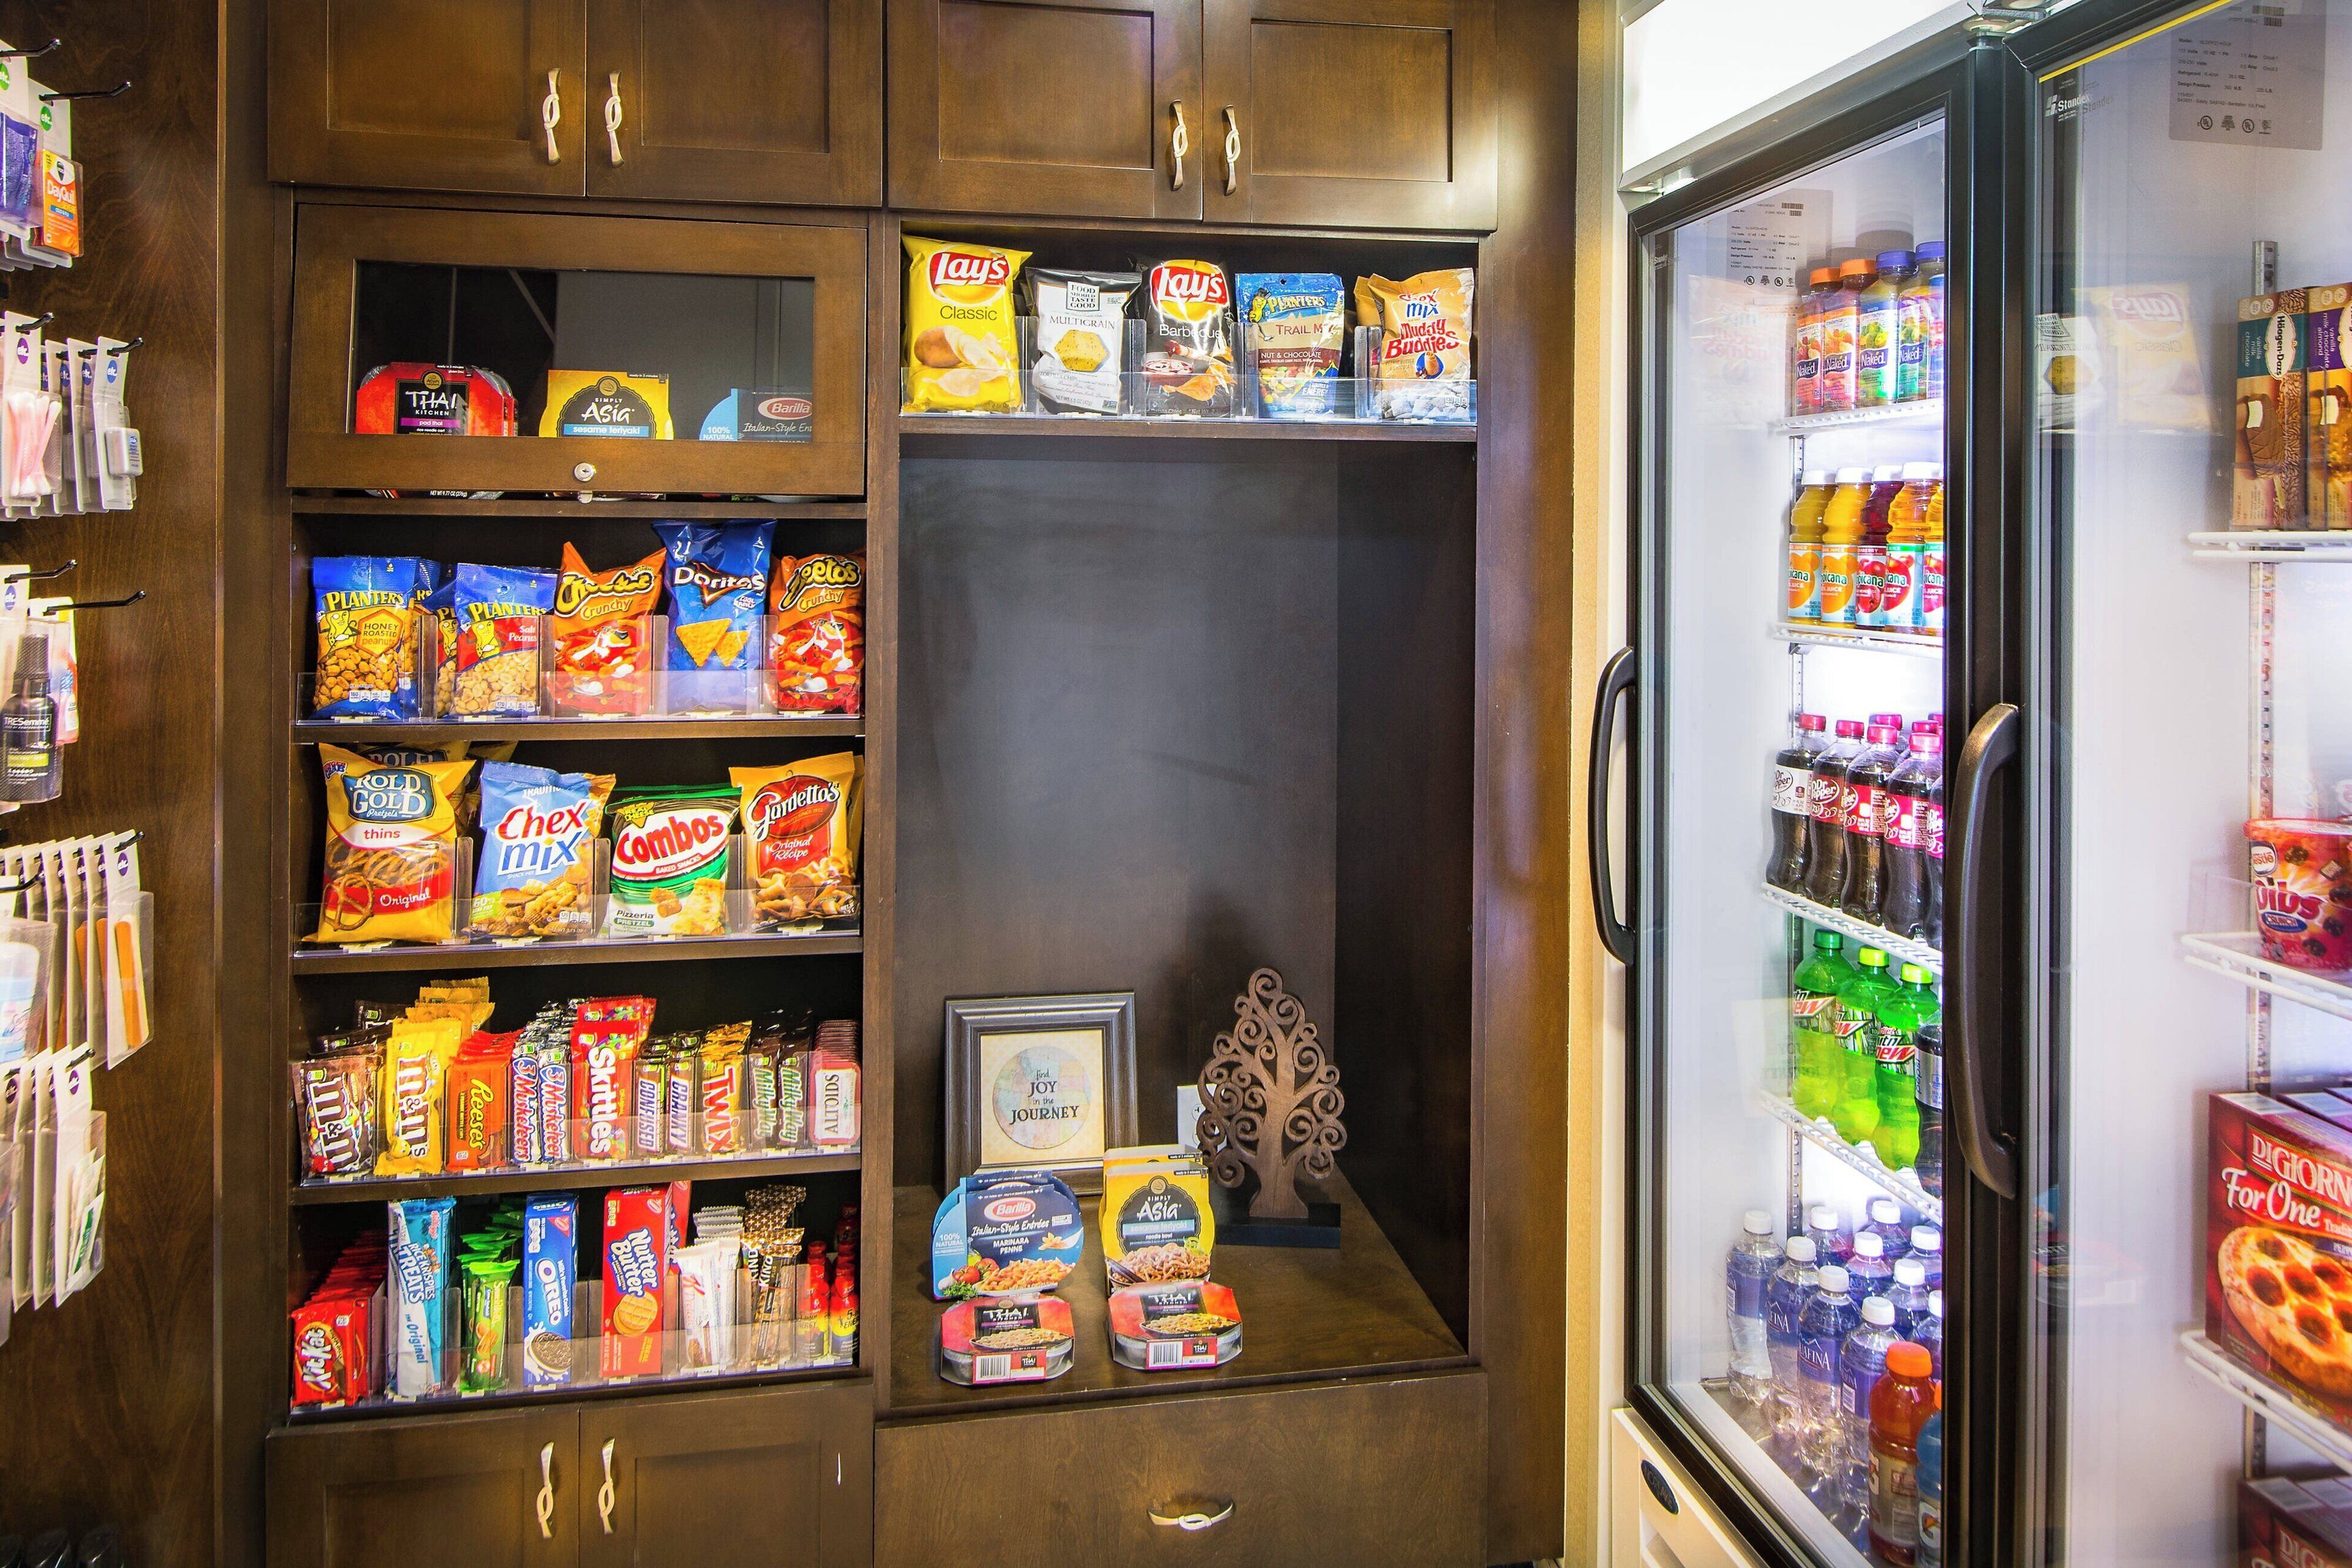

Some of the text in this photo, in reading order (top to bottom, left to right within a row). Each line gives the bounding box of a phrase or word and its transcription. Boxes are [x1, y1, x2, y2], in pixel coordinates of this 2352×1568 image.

[40, 112, 53, 126] etc.
[47, 178, 74, 205] DayQui
[931, 251, 1008, 286] Lay's
[1071, 284, 1096, 294] FOOD
[1156, 265, 1223, 302] Lay's
[940, 305, 998, 321] Classic
[1267, 295, 1326, 312] PLANTERS
[1049, 315, 1115, 330] MULTIGRAIN
[1276, 324, 1311, 335] TRAIL
[1401, 318, 1447, 340] Muddy
[17, 345, 29, 357] etc.
[1384, 330, 1460, 360] Buddies
[1900, 346, 1920, 363] Naked
[2275, 315, 2286, 376] Häagen-Dazs
[1797, 362, 1815, 377] Naked
[1826, 356, 1848, 370] Naked
[1861, 352, 1885, 367] Naked
[107, 367, 118, 377] etc.
[405, 391, 456, 409] THAI
[770, 402, 810, 414] Barilla
[581, 402, 630, 424] Asia
[609, 426, 640, 435] teriyaki
[742, 423, 796, 435] Italian-Style
[674, 566, 766, 591] Doritos
[325, 591, 404, 611] PLANTERS
[582, 598, 632, 619] Crunchy
[798, 590, 843, 611] Crunchy
[469, 601, 547, 622] PLANTERS
[362, 637, 396, 646] peanuts
[354, 774, 421, 791] ROLD
[1816, 778, 1828, 788] Dr
[353, 790, 427, 815] GOLD
[747, 782, 841, 843] Gardetto's
[366, 809, 398, 818] Pretzels
[497, 801, 587, 840] Chex
[364, 828, 401, 840] thins
[616, 815, 725, 865] Combos
[770, 834, 814, 853] Original
[501, 831, 583, 872] mix
[772, 850, 809, 861] Recipe
[655, 854, 702, 874] BAKED SNACKS
[379, 888, 431, 908] Original
[616, 910, 655, 919] Pizzeria
[2266, 915, 2297, 927] CRUNCH
[546, 1066, 564, 1083] 3
[1036, 1068, 1050, 1079] find
[753, 1068, 776, 1107] Milky
[1029, 1080, 1058, 1098] JOY
[587, 1047, 617, 1153] Skittles
[703, 1066, 735, 1152] TWIX
[780, 1067, 803, 1142] Milky Way
[824, 1073, 839, 1134] ALTOIDS
[1033, 1095, 1054, 1105] in the
[469, 1078, 494, 1150] Reese's
[514, 1059, 537, 1162] 3 Musketeers
[638, 1080, 655, 1150] CONFUSED
[671, 1079, 688, 1145] CRANKY
[1008, 1104, 1080, 1126] JOURNEY
[2252, 1133, 2352, 1207] DIGIORN
[2222, 1167, 2321, 1228] For One
[996, 1201, 1032, 1215] Barilla
[1137, 1200, 1178, 1222] Asia
[971, 1221, 1020, 1237] Italian-Style
[1021, 1218, 1050, 1231] Entrées
[1131, 1223, 1159, 1232] sesame
[936, 1238, 964, 1248] NATURAL
[993, 1237, 1030, 1248] MARINARA
[1000, 1245, 1023, 1254] PENNE
[611, 1239, 644, 1297] Butter
[627, 1227, 658, 1289] Nutter
[748, 1250, 759, 1282] KIND
[398, 1243, 425, 1304] TREATS
[408, 1243, 436, 1300] RICE KRISPIES
[758, 1256, 774, 1287] KIND
[537, 1258, 562, 1326] OREO
[1148, 1292, 1191, 1302] THAI
[982, 1307, 1028, 1319] THAI
[407, 1324, 428, 1364] Original
